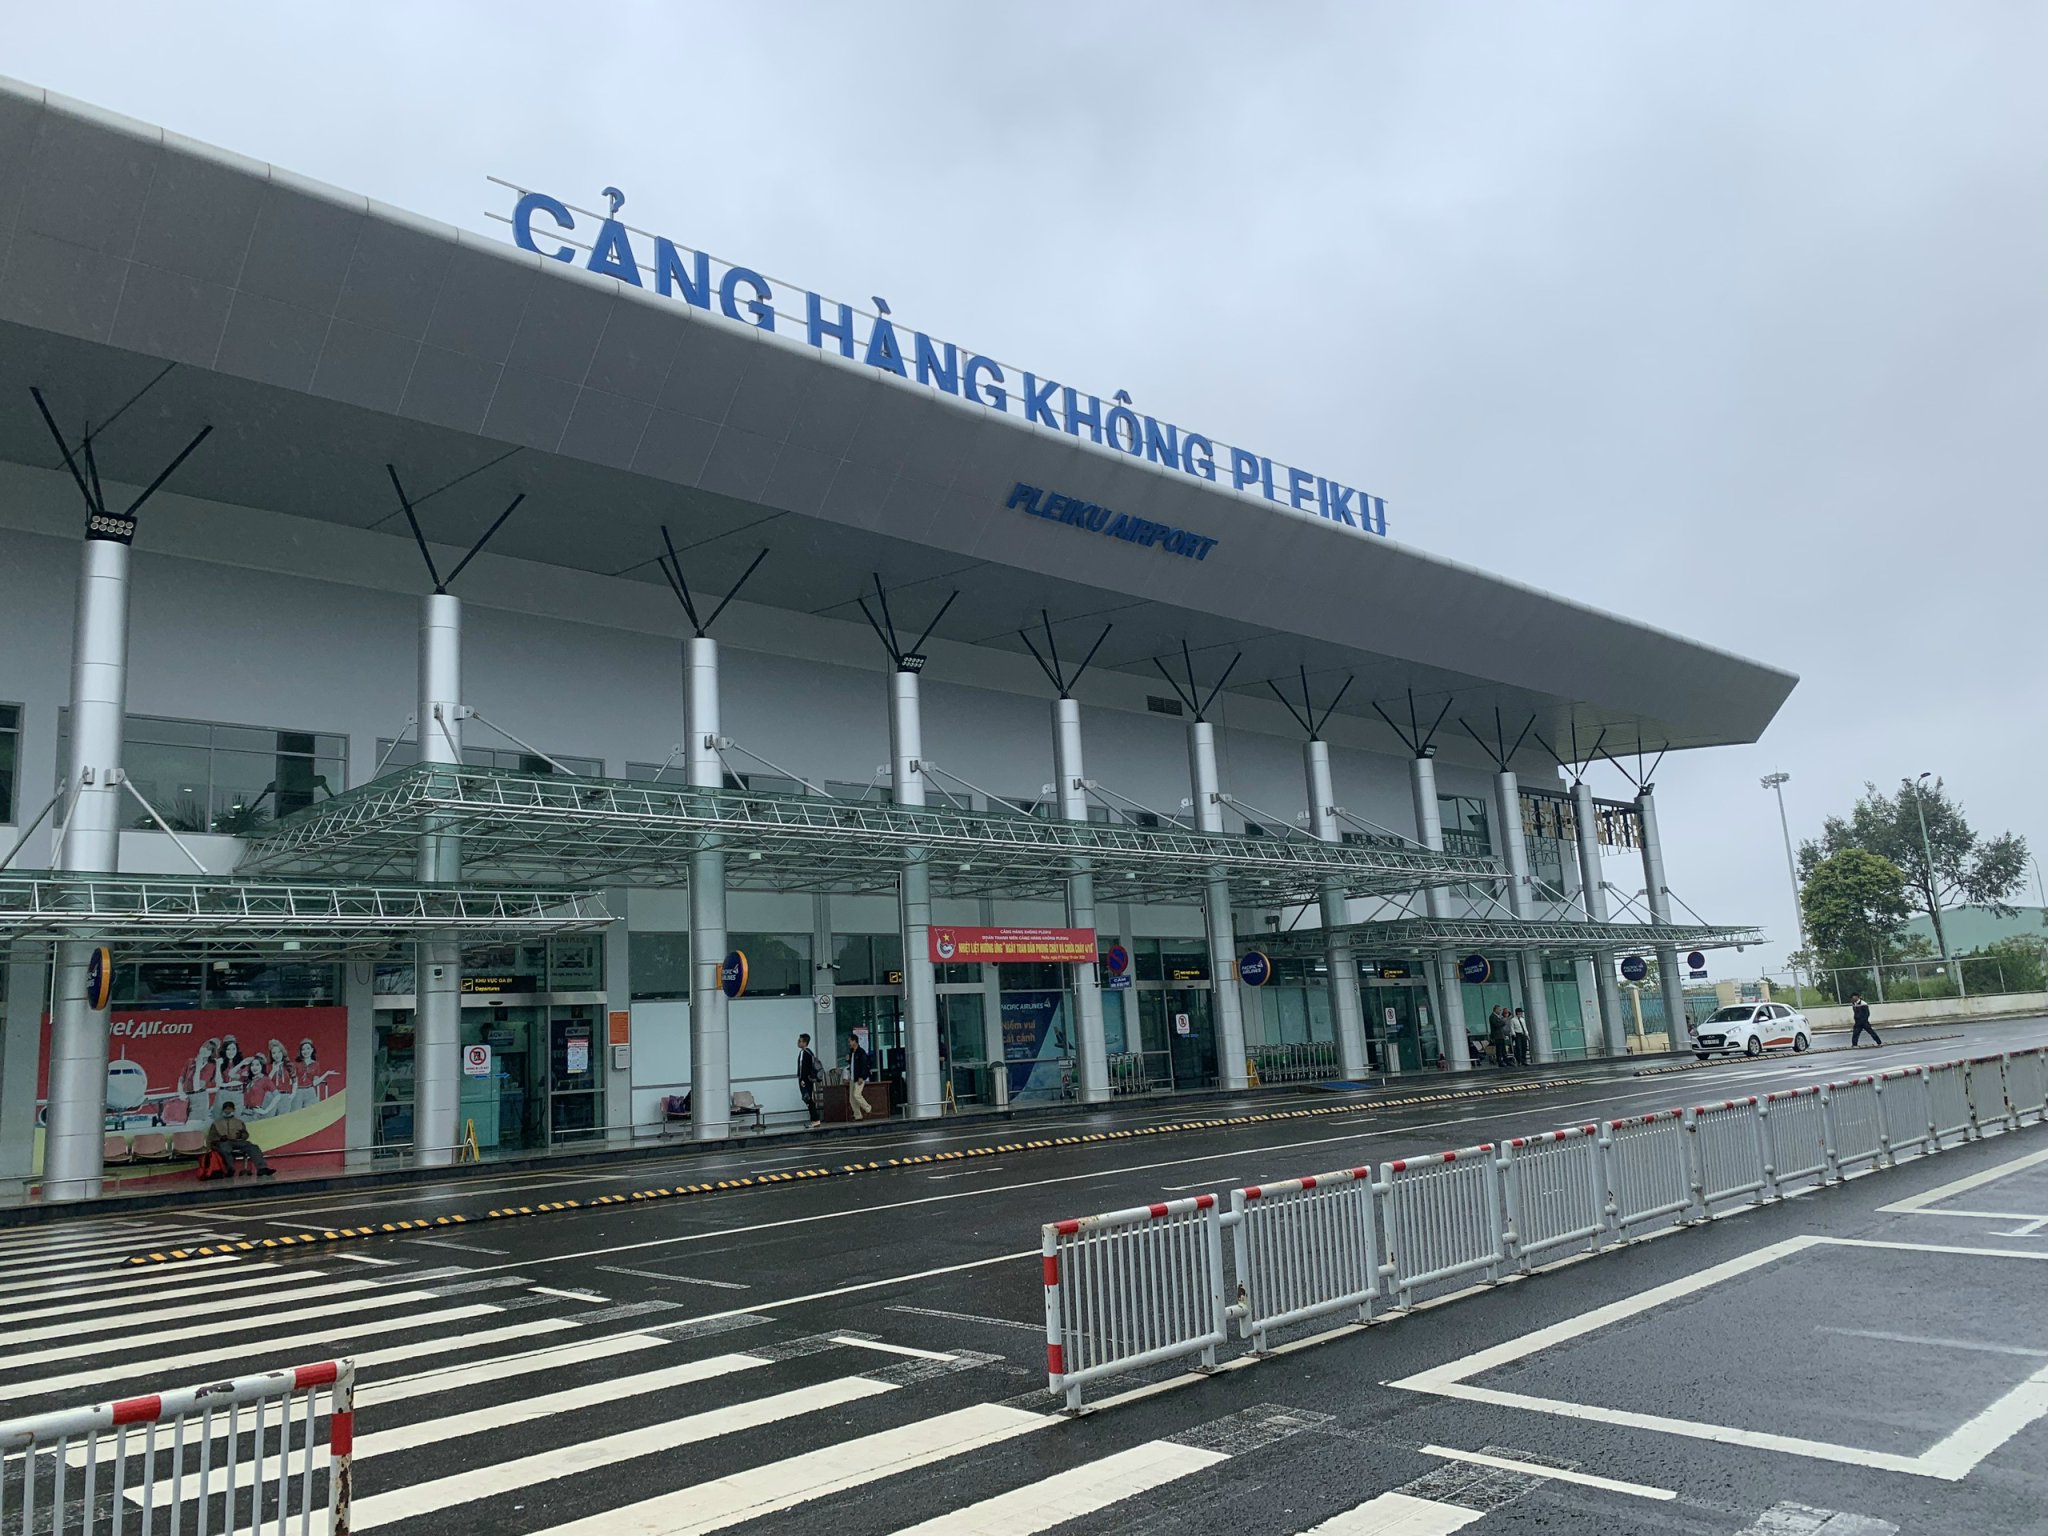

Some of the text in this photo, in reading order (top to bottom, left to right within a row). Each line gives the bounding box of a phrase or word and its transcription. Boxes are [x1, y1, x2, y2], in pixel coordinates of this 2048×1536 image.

[512, 186, 1388, 537] CẢNG HÀNG KHÔNG PLEIKU
[1006, 482, 1219, 561] PLEIKU AIRPORT
